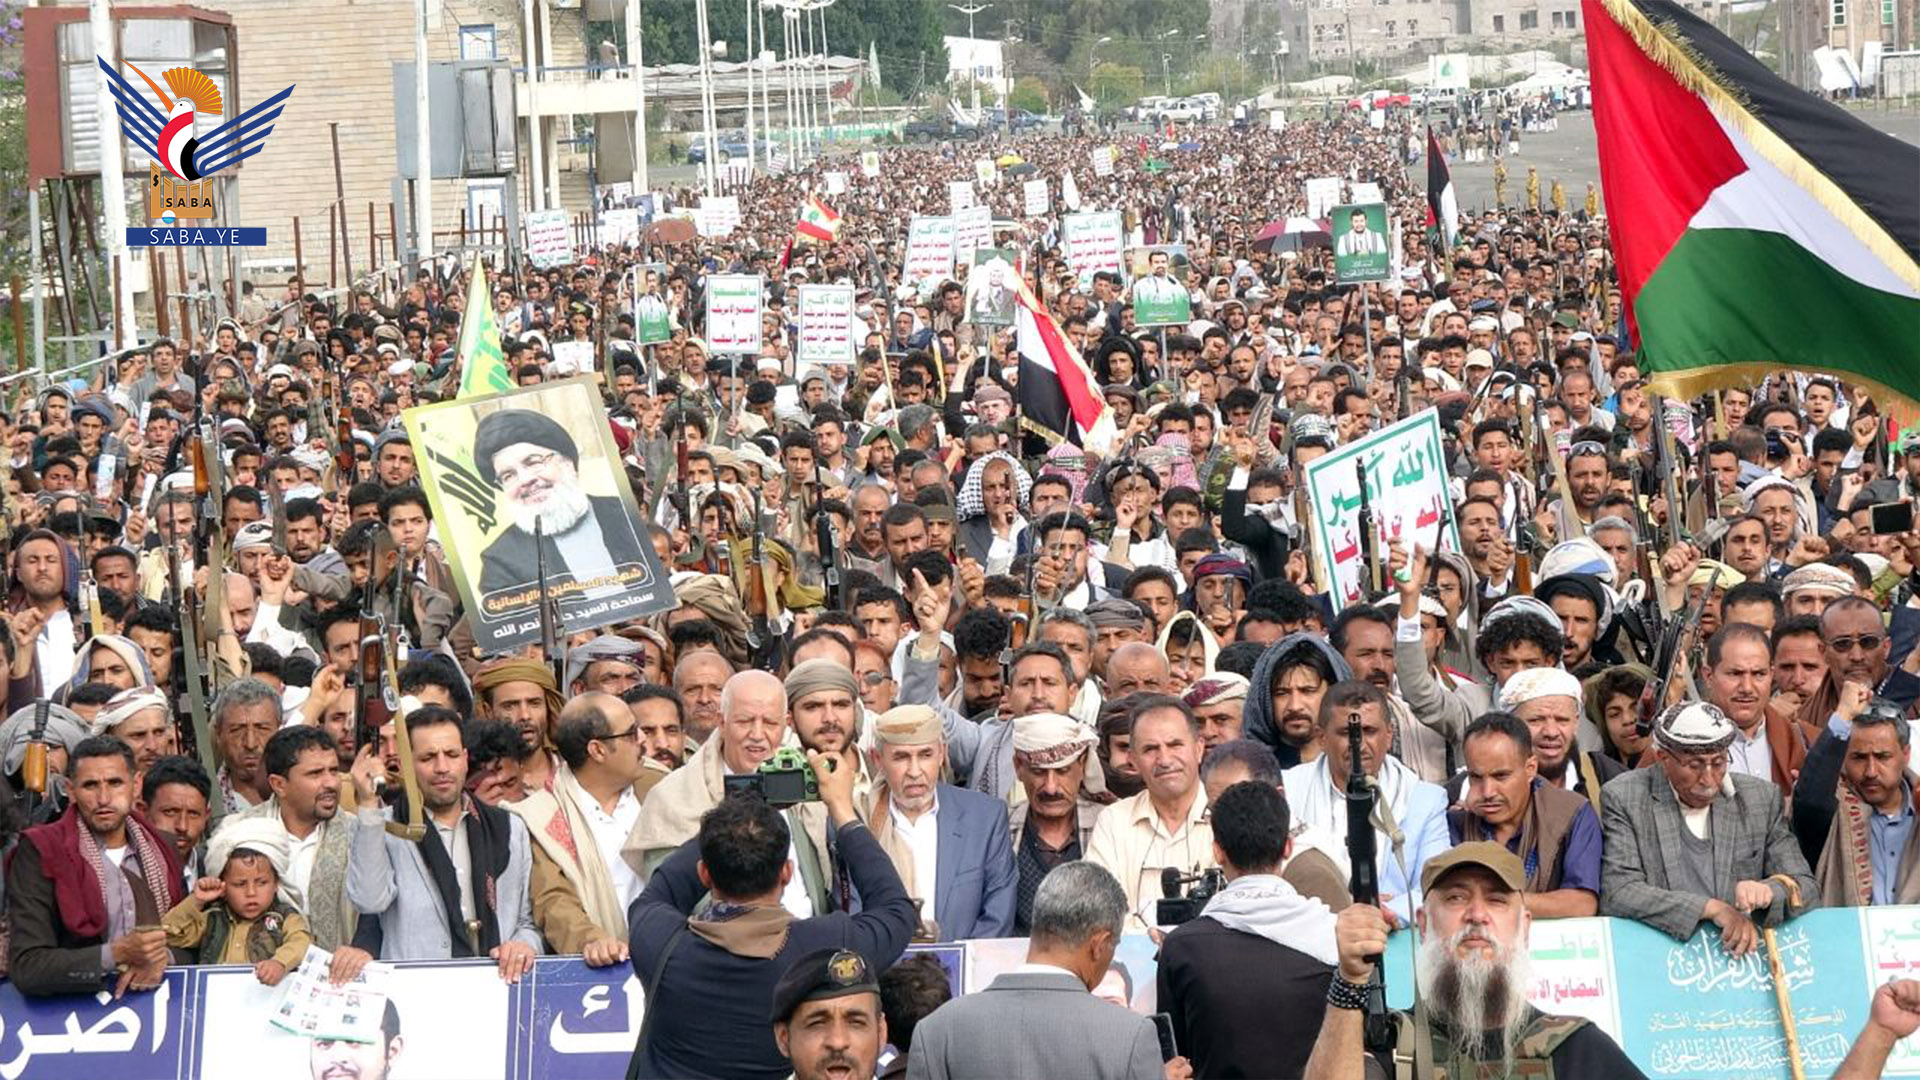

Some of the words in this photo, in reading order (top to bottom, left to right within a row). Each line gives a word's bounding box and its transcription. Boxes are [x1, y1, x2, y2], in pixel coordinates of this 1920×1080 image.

[1392, 435, 1436, 487] الله
[610, 591, 655, 610] سماحة
[576, 603, 610, 619] السيد
[493, 623, 519, 639] الله
[518, 618, 541, 635] نصر
